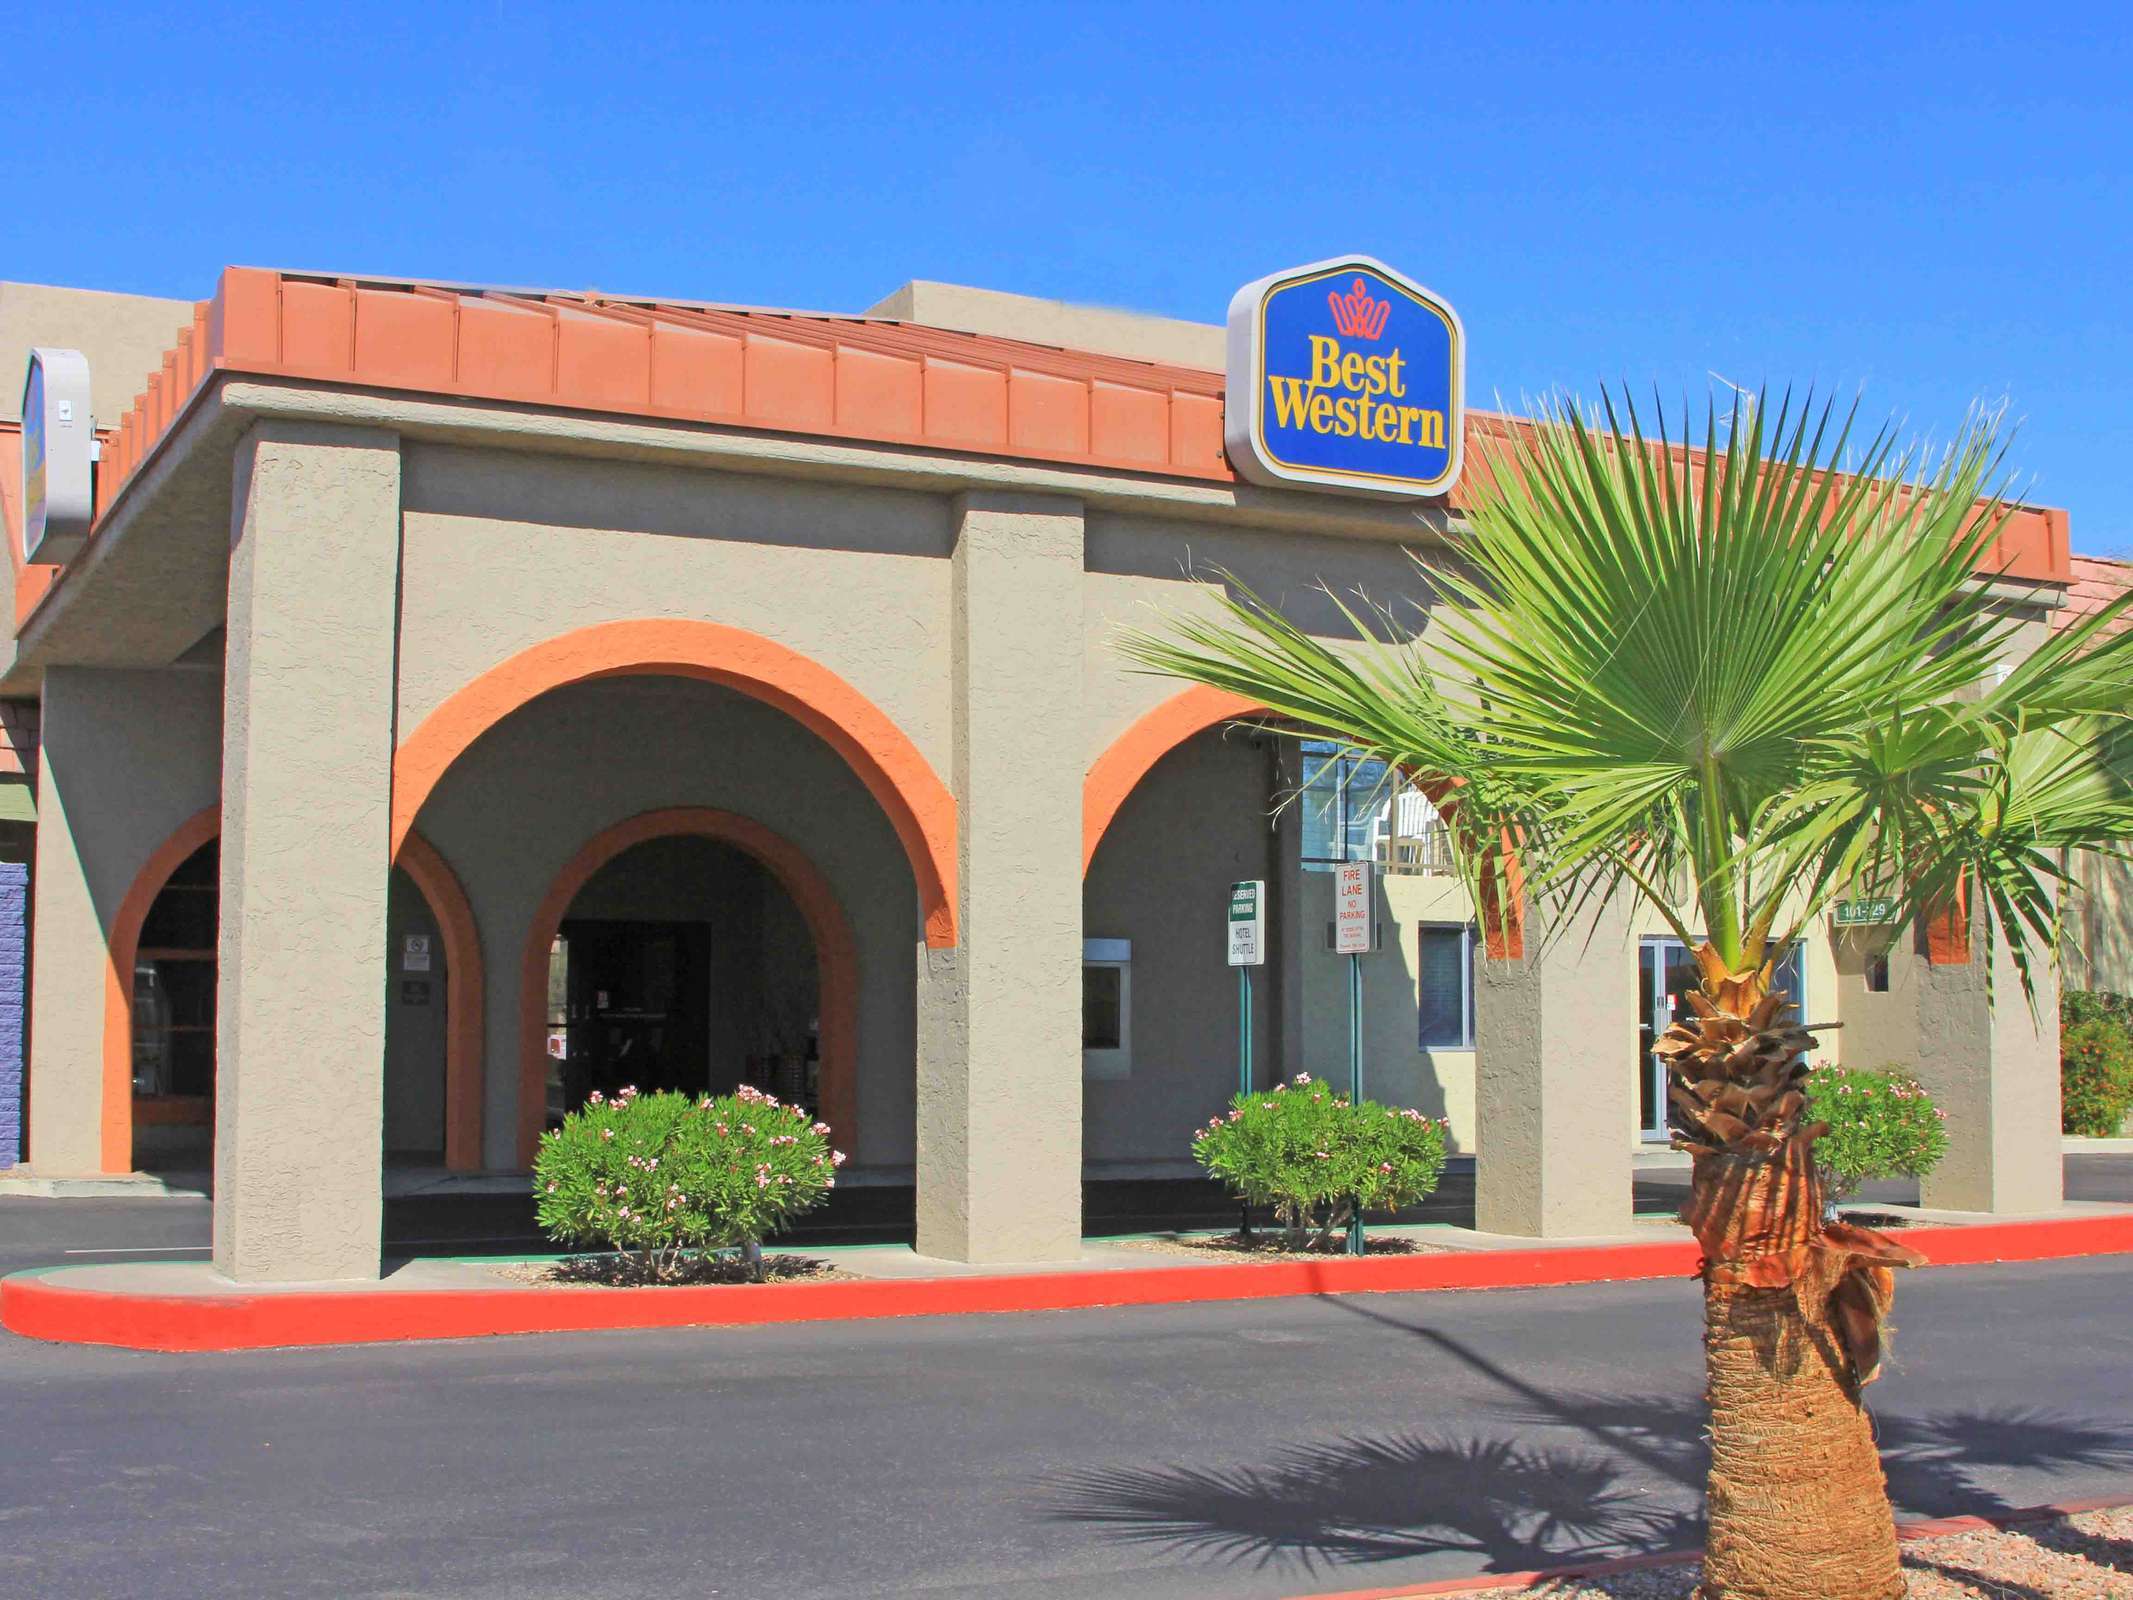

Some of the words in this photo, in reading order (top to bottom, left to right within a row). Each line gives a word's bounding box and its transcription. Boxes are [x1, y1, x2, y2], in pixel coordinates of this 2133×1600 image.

[1308, 335, 1406, 398] Best
[1268, 375, 1446, 449] Western
[1343, 869, 1360, 881] FIRE
[1341, 884, 1362, 897] LANE
[1232, 903, 1254, 914] PARKING
[1347, 900, 1357, 909] NO
[1339, 911, 1366, 920] PARKING
[1235, 927, 1252, 939] HOTEL
[1232, 943, 1255, 955] SHUTTLE
